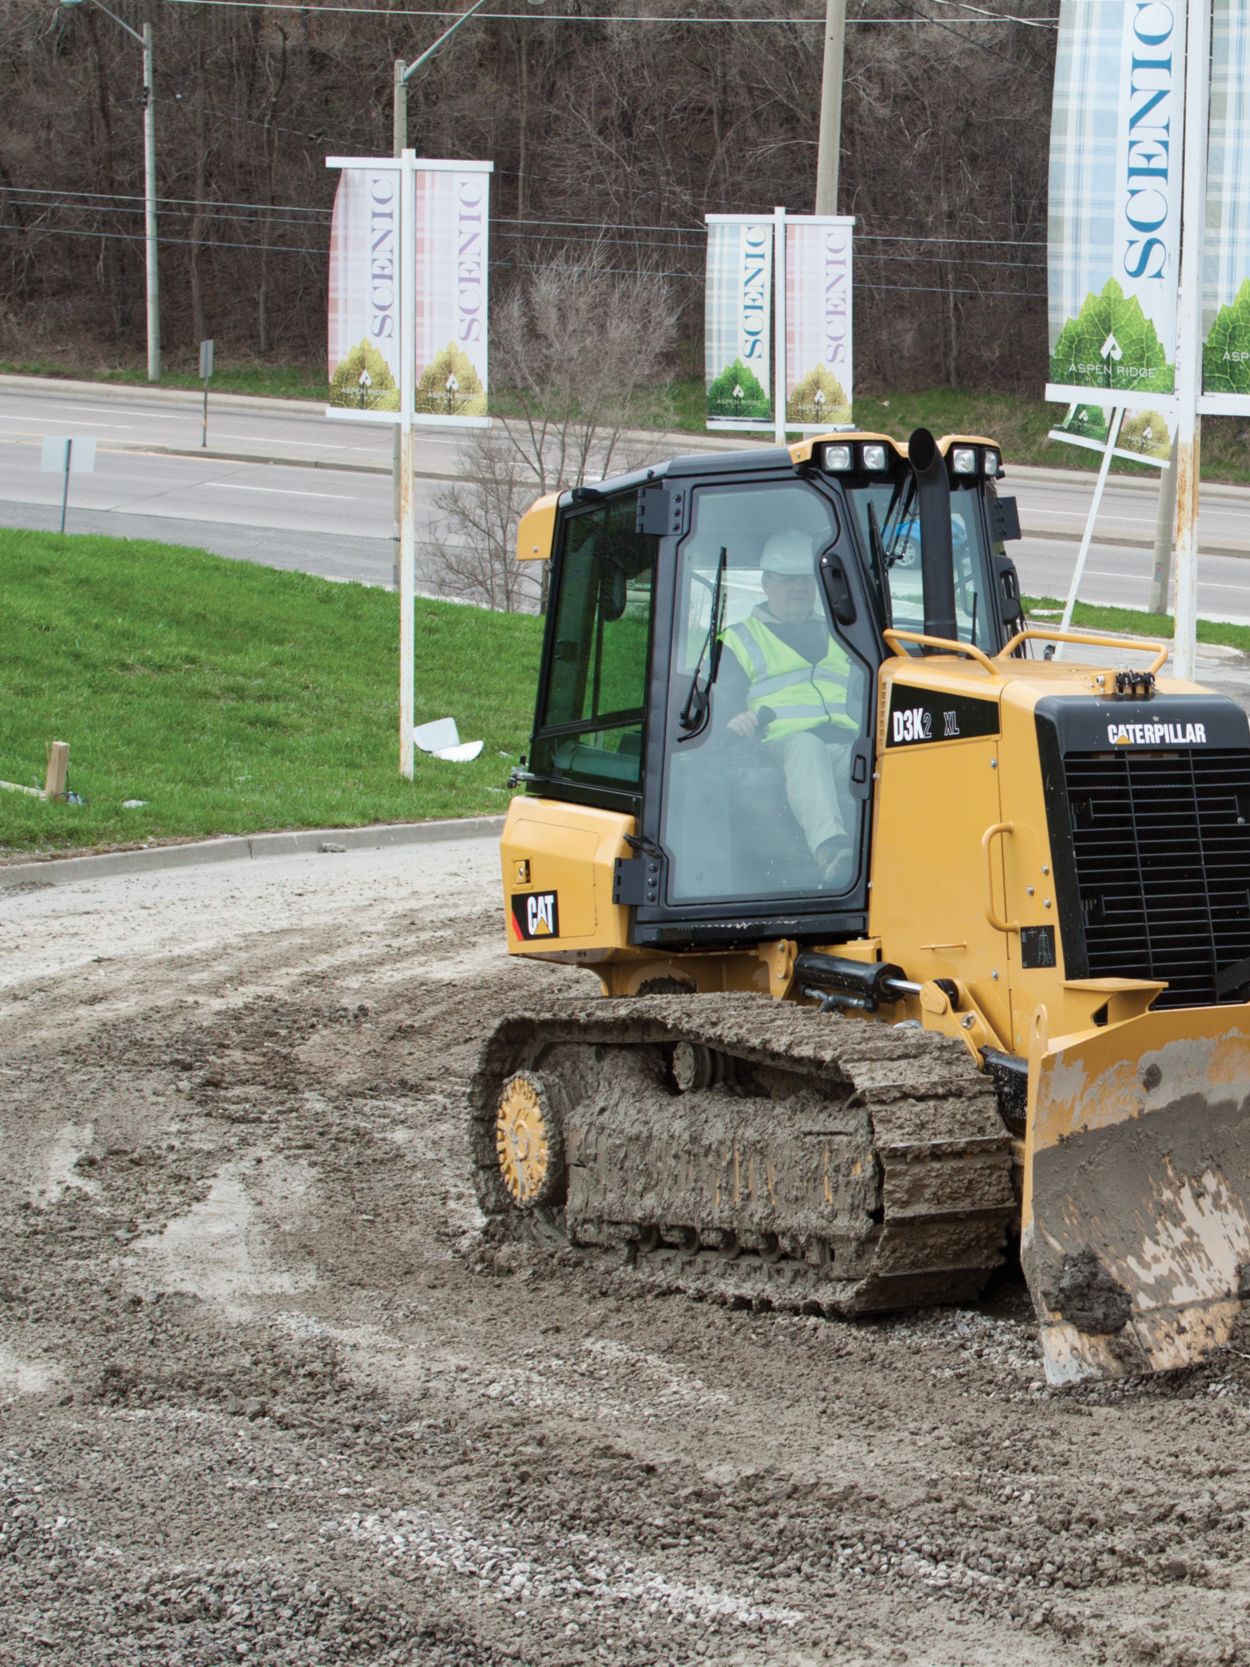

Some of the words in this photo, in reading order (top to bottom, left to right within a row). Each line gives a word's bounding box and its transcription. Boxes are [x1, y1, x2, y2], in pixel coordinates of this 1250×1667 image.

[1123, 2, 1175, 280] SCENIC
[370, 178, 394, 339] SCENIC
[457, 181, 483, 342] SCENIC
[743, 226, 767, 359] SCENIC
[825, 232, 847, 364] SCENIC
[1068, 363, 1112, 375] ASPEN
[1116, 366, 1157, 379] RIDGE
[943, 710, 960, 736] XL
[1107, 722, 1207, 745] CATERPILLAR
[527, 894, 555, 936] CAT
